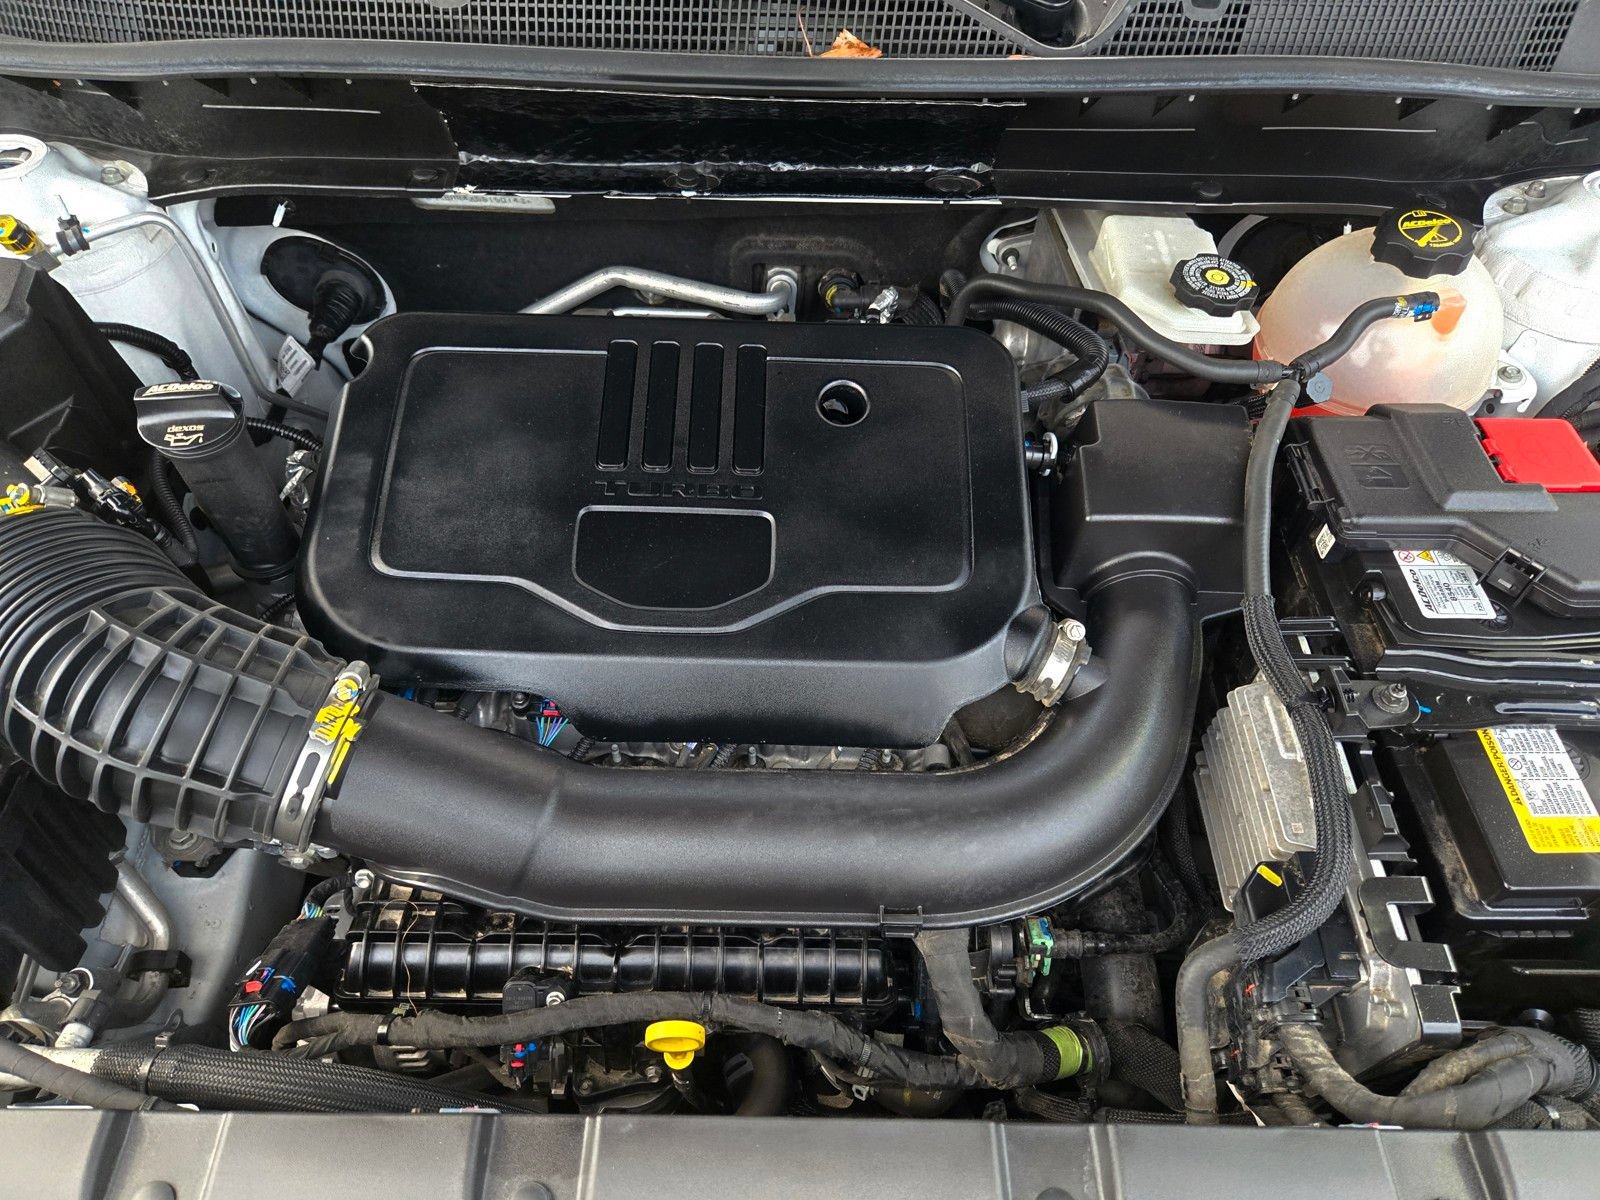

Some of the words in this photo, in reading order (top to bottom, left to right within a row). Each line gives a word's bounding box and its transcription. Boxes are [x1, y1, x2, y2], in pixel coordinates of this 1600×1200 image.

[1402, 219, 1451, 229] ACDelco
[144, 382, 214, 395] ACDelco
[167, 424, 205, 433] dexos
[595, 480, 763, 500] TURBO
[1409, 569, 1433, 611] ACDelco
[1443, 582, 1457, 602] 8540
